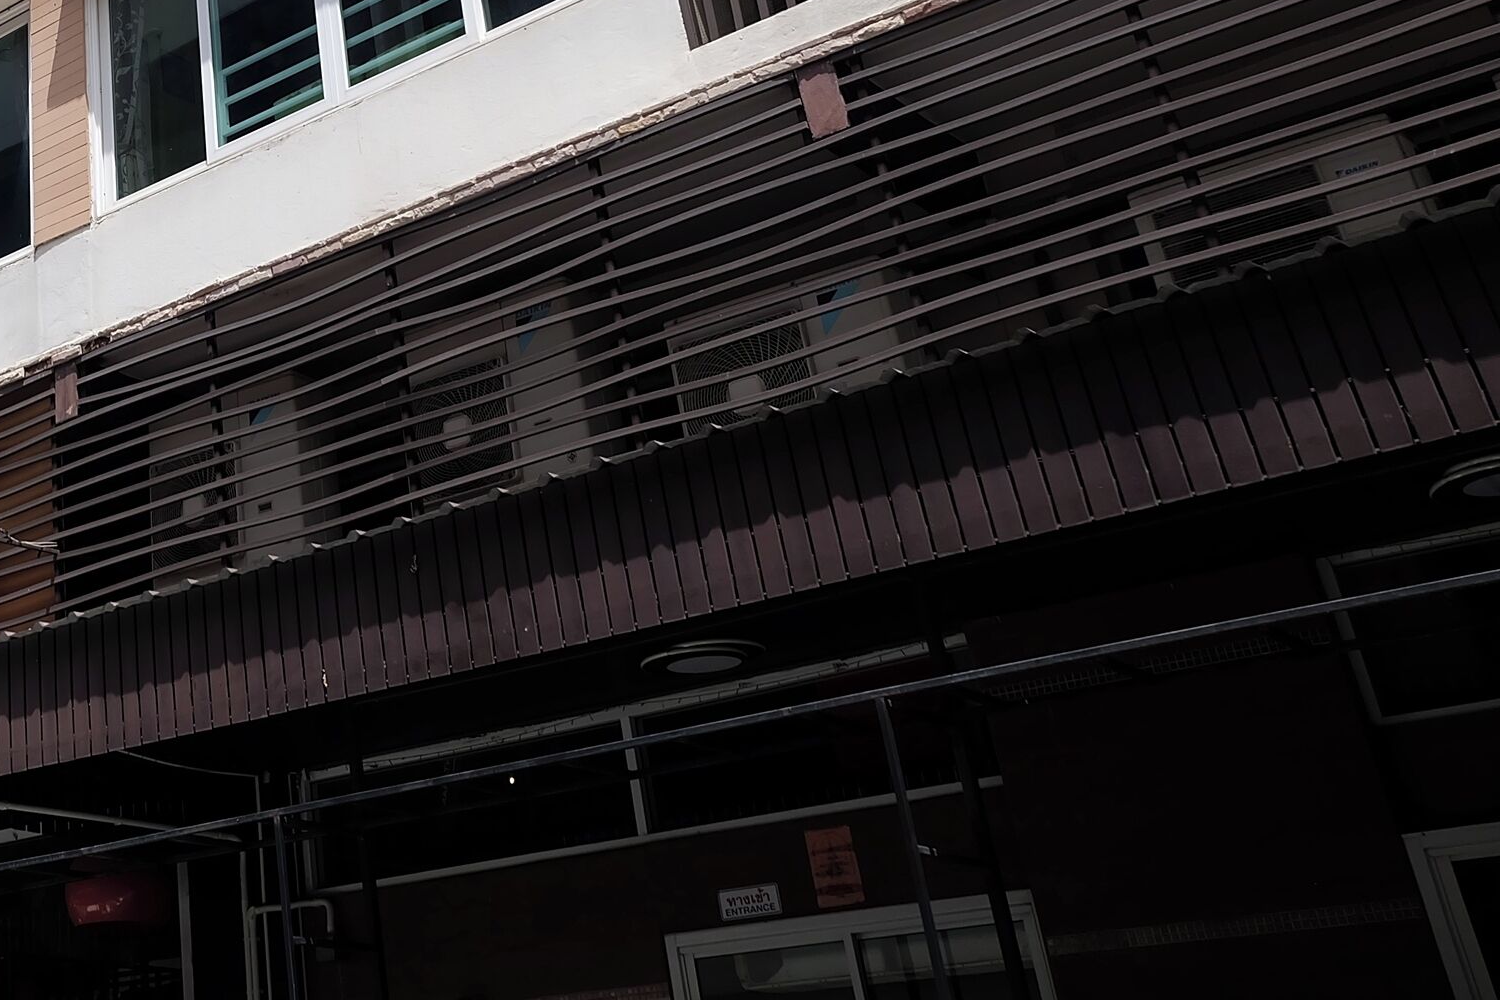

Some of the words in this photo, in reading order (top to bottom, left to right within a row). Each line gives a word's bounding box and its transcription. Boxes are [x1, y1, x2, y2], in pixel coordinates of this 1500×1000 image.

[1345, 161, 1379, 175] DAIKIN
[726, 887, 771, 907] ทางเข้า
[725, 902, 776, 917] ENTRANCE
